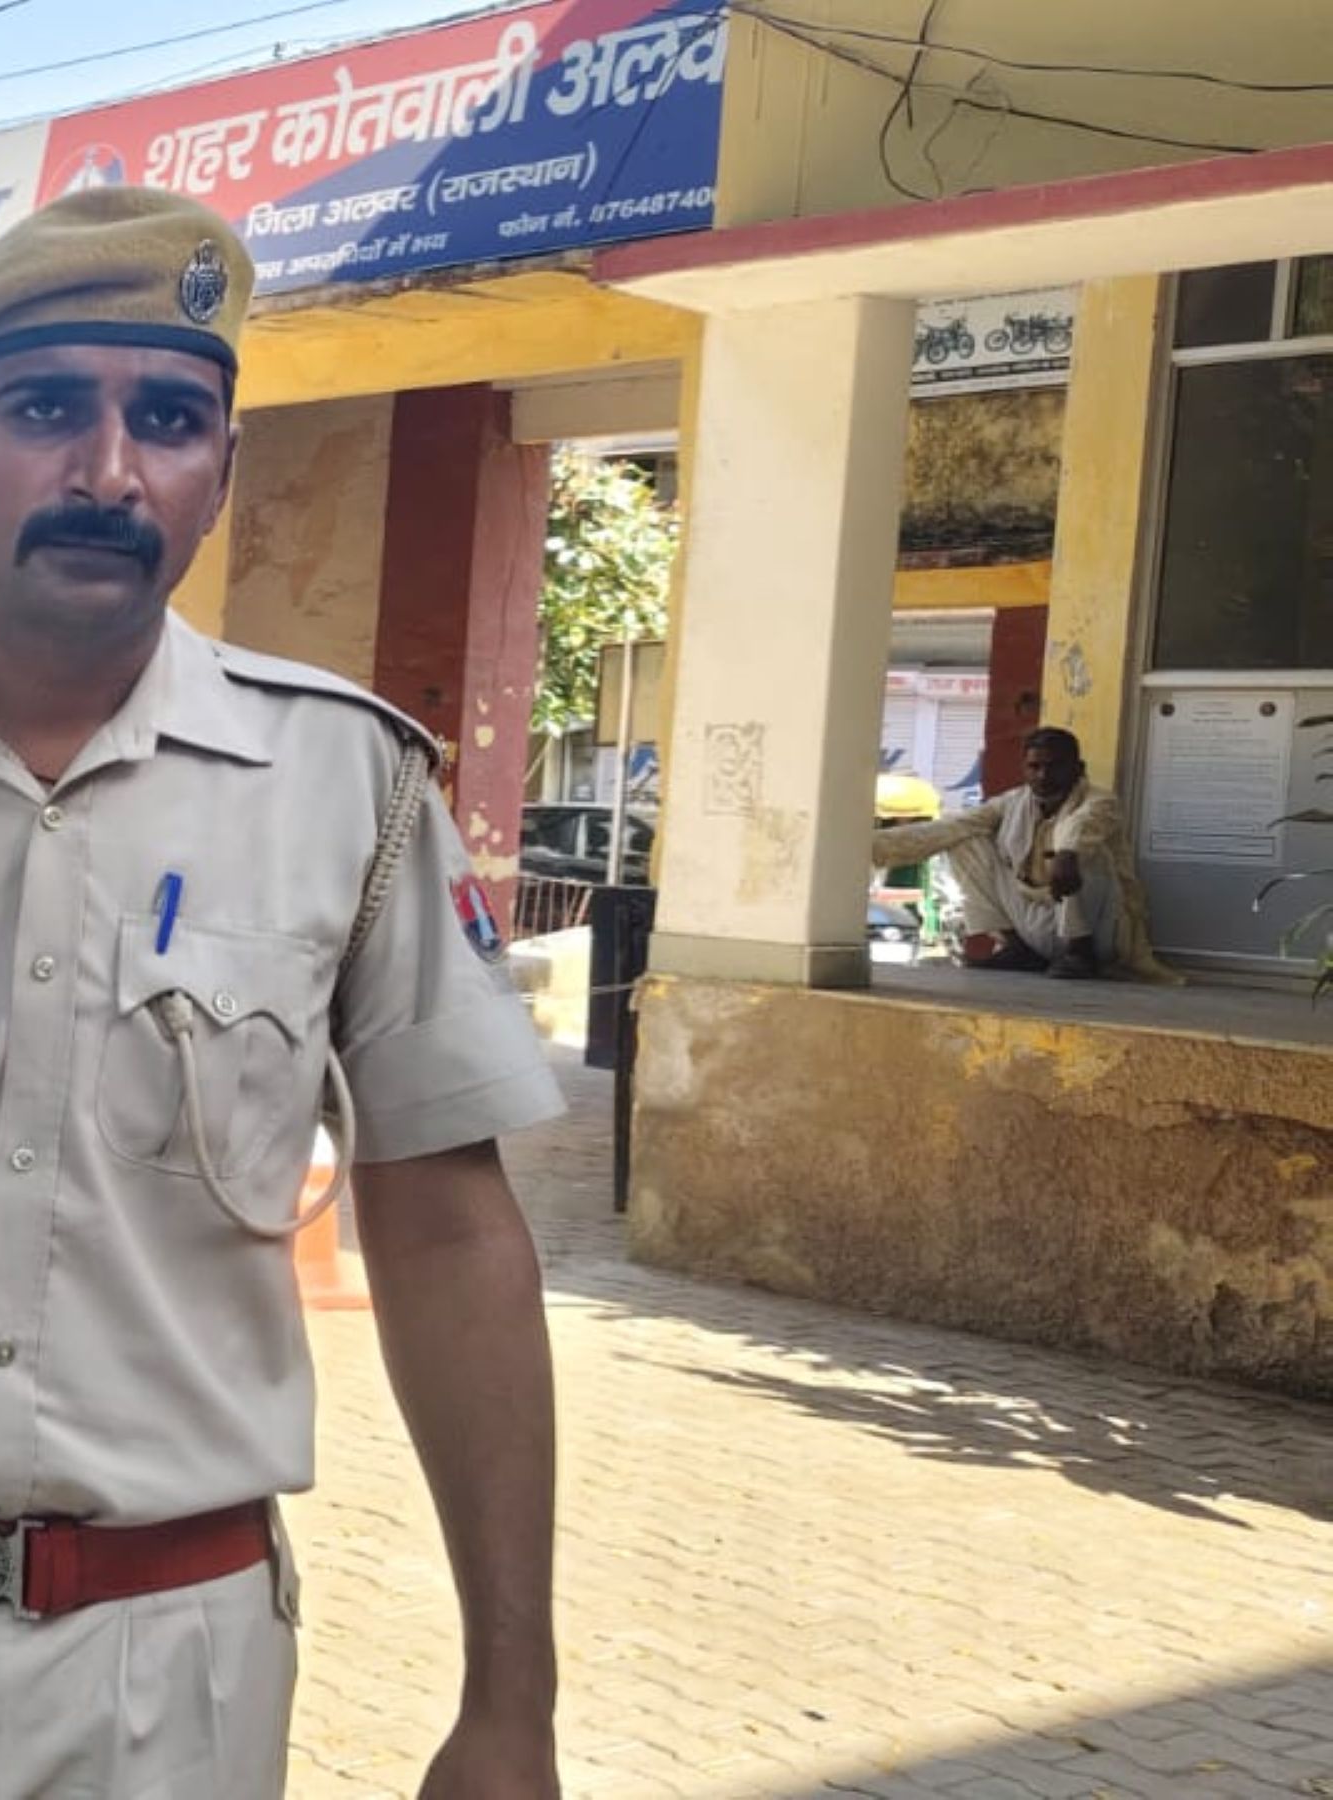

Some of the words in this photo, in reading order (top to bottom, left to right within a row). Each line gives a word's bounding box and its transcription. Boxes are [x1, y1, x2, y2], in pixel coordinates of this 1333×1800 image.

[143, 110, 267, 194] शहर
[272, 21, 541, 168] कोतवाली
[545, 7, 730, 115] अलव
[245, 202, 319, 238] जिला
[322, 183, 421, 225] अलवर
[427, 142, 597, 215] (राजस्थान)
